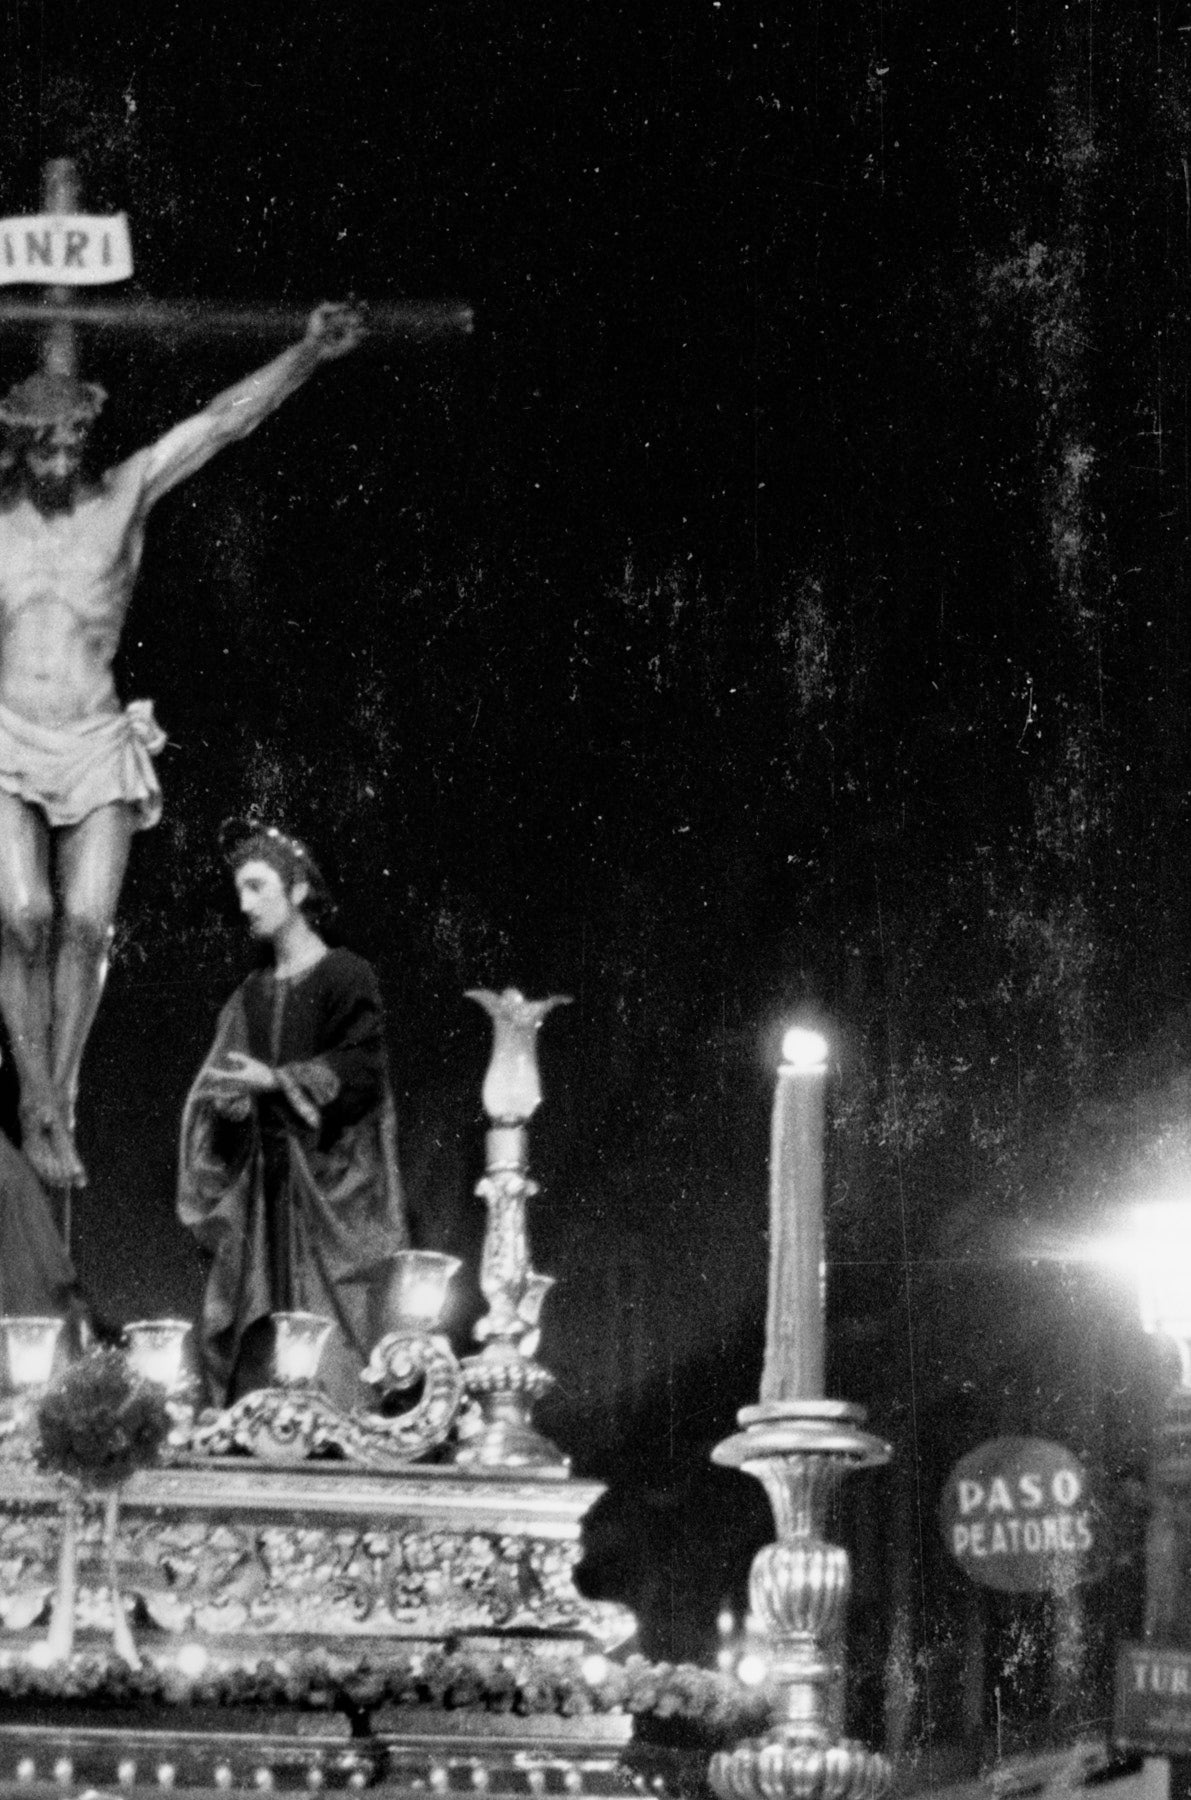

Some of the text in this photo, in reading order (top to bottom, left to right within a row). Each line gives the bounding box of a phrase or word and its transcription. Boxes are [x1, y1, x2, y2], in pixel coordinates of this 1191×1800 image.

[4, 230, 112, 268] INRI
[959, 1469, 1081, 1515] PASO
[953, 1517, 1093, 1558] PEATONES
